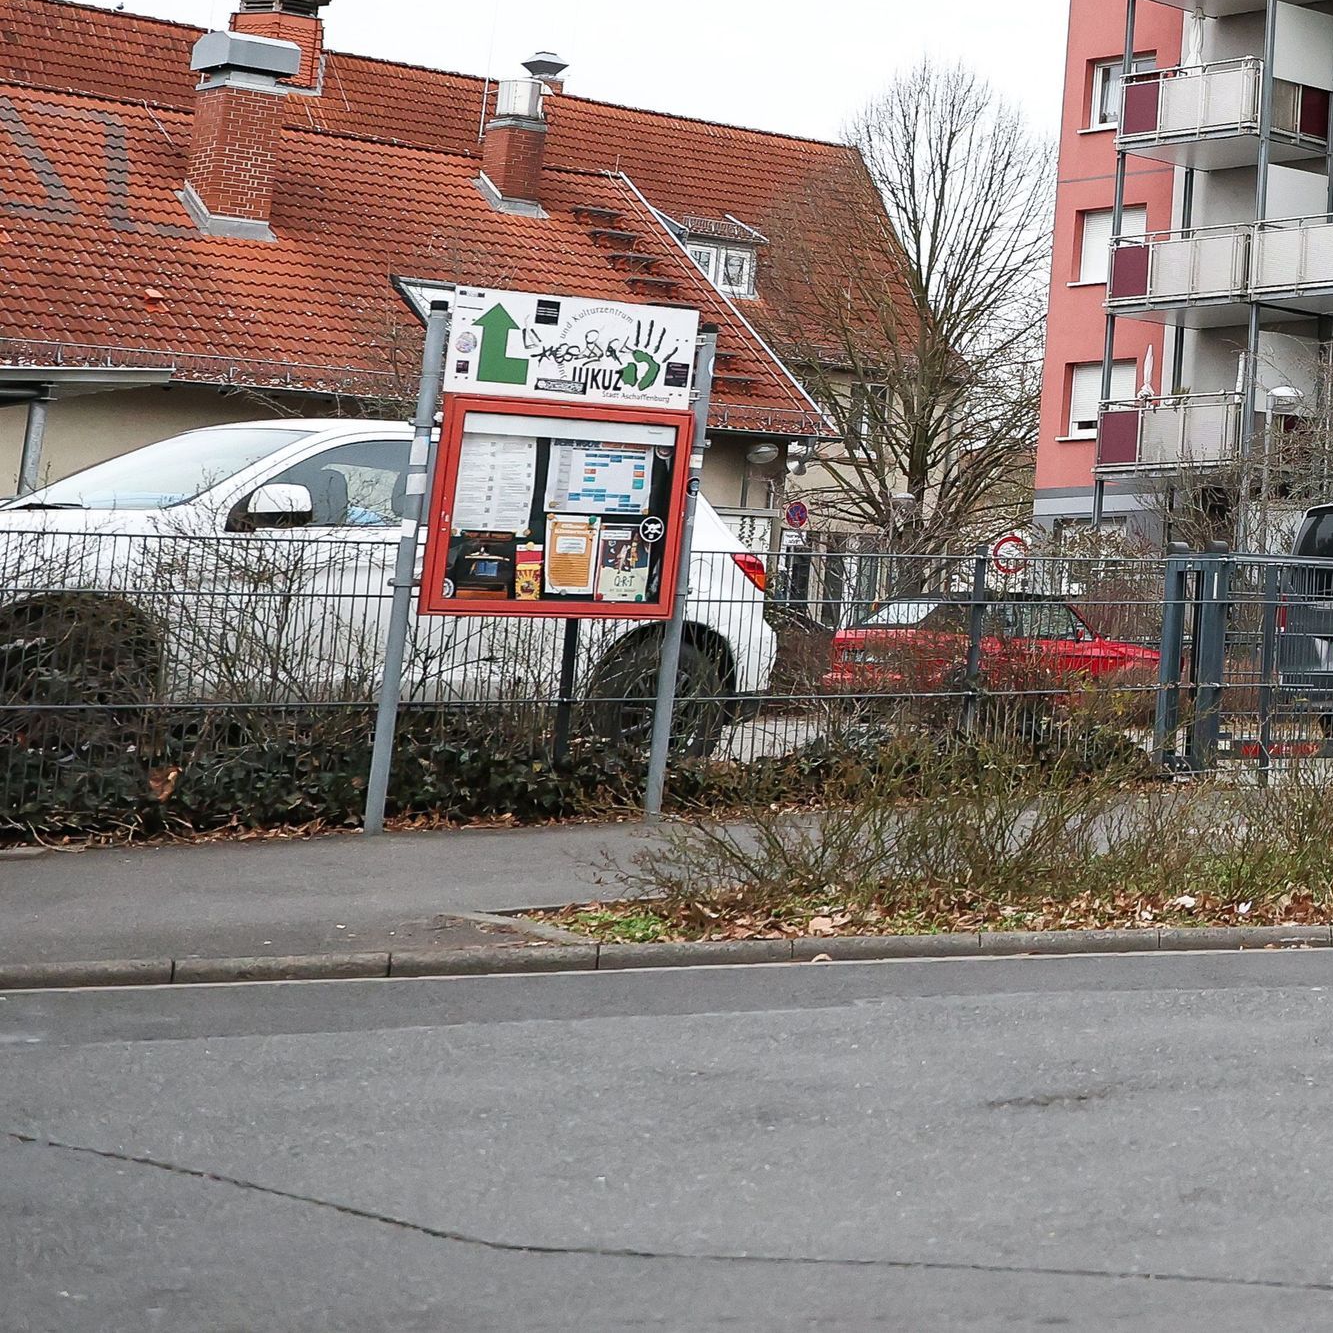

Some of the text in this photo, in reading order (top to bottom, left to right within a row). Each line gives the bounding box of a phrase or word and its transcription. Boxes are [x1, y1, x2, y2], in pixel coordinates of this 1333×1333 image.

[560, 322, 572, 339] und
[572, 307, 633, 324] Kulturzentrum
[621, 393, 670, 403] Aschaffenburg
